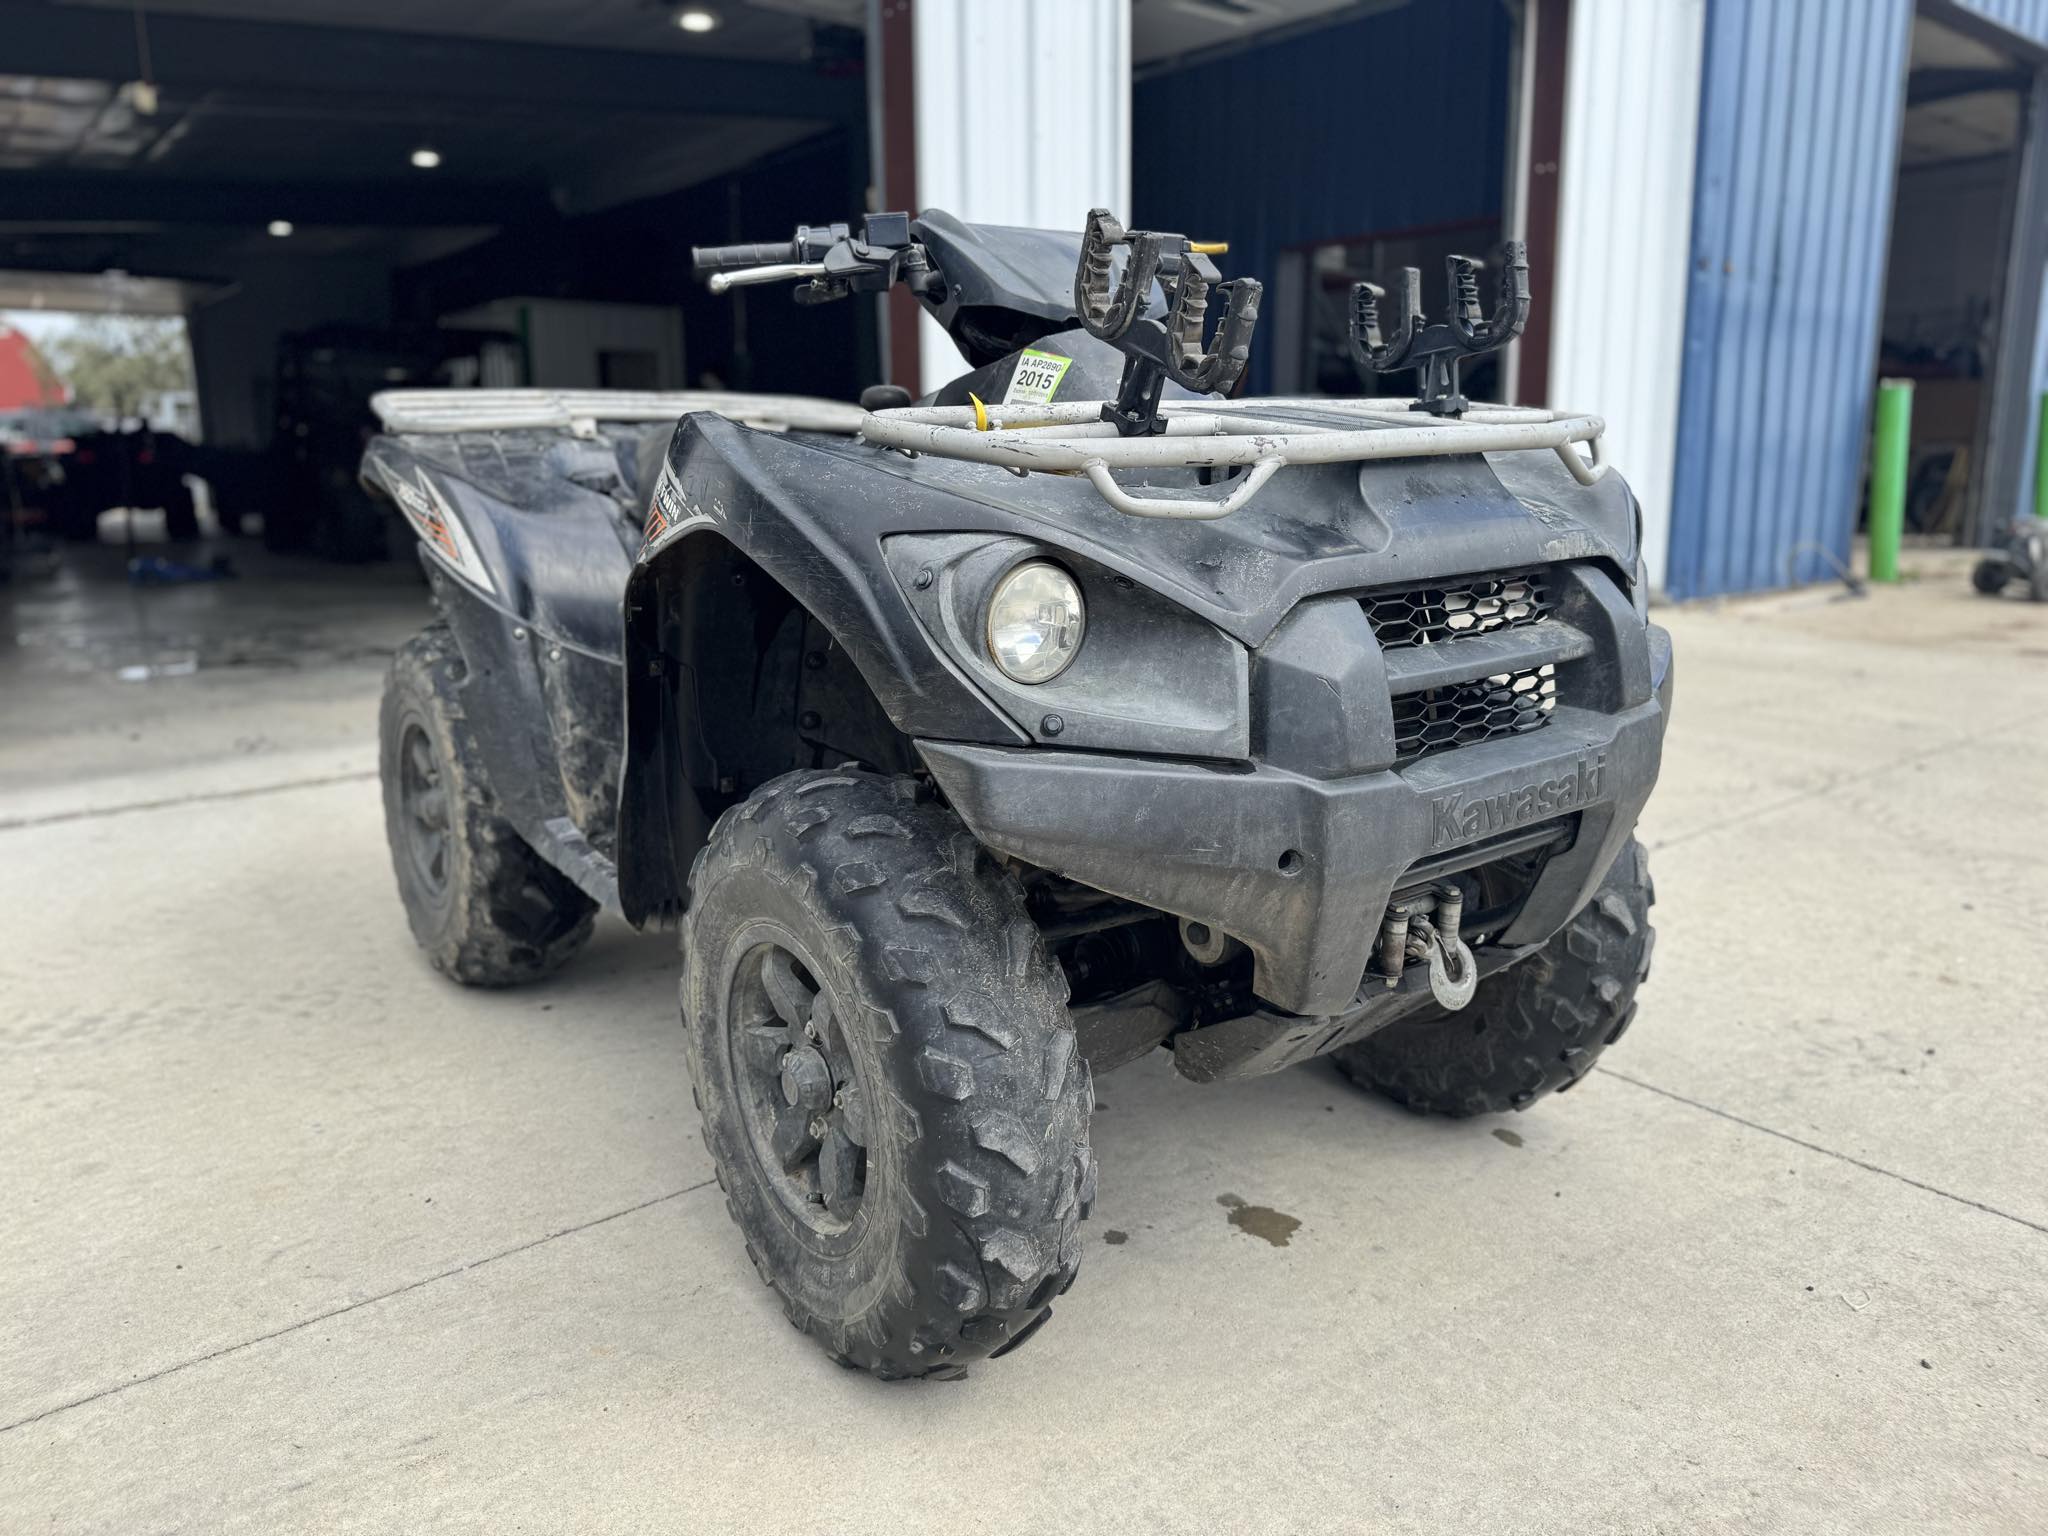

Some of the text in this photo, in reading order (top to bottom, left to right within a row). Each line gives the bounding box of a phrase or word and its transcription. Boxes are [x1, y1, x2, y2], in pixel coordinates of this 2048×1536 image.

[1021, 357, 1029, 366] IA
[1016, 370, 1054, 389] 2015
[1431, 752, 1607, 848] Kawasaki
